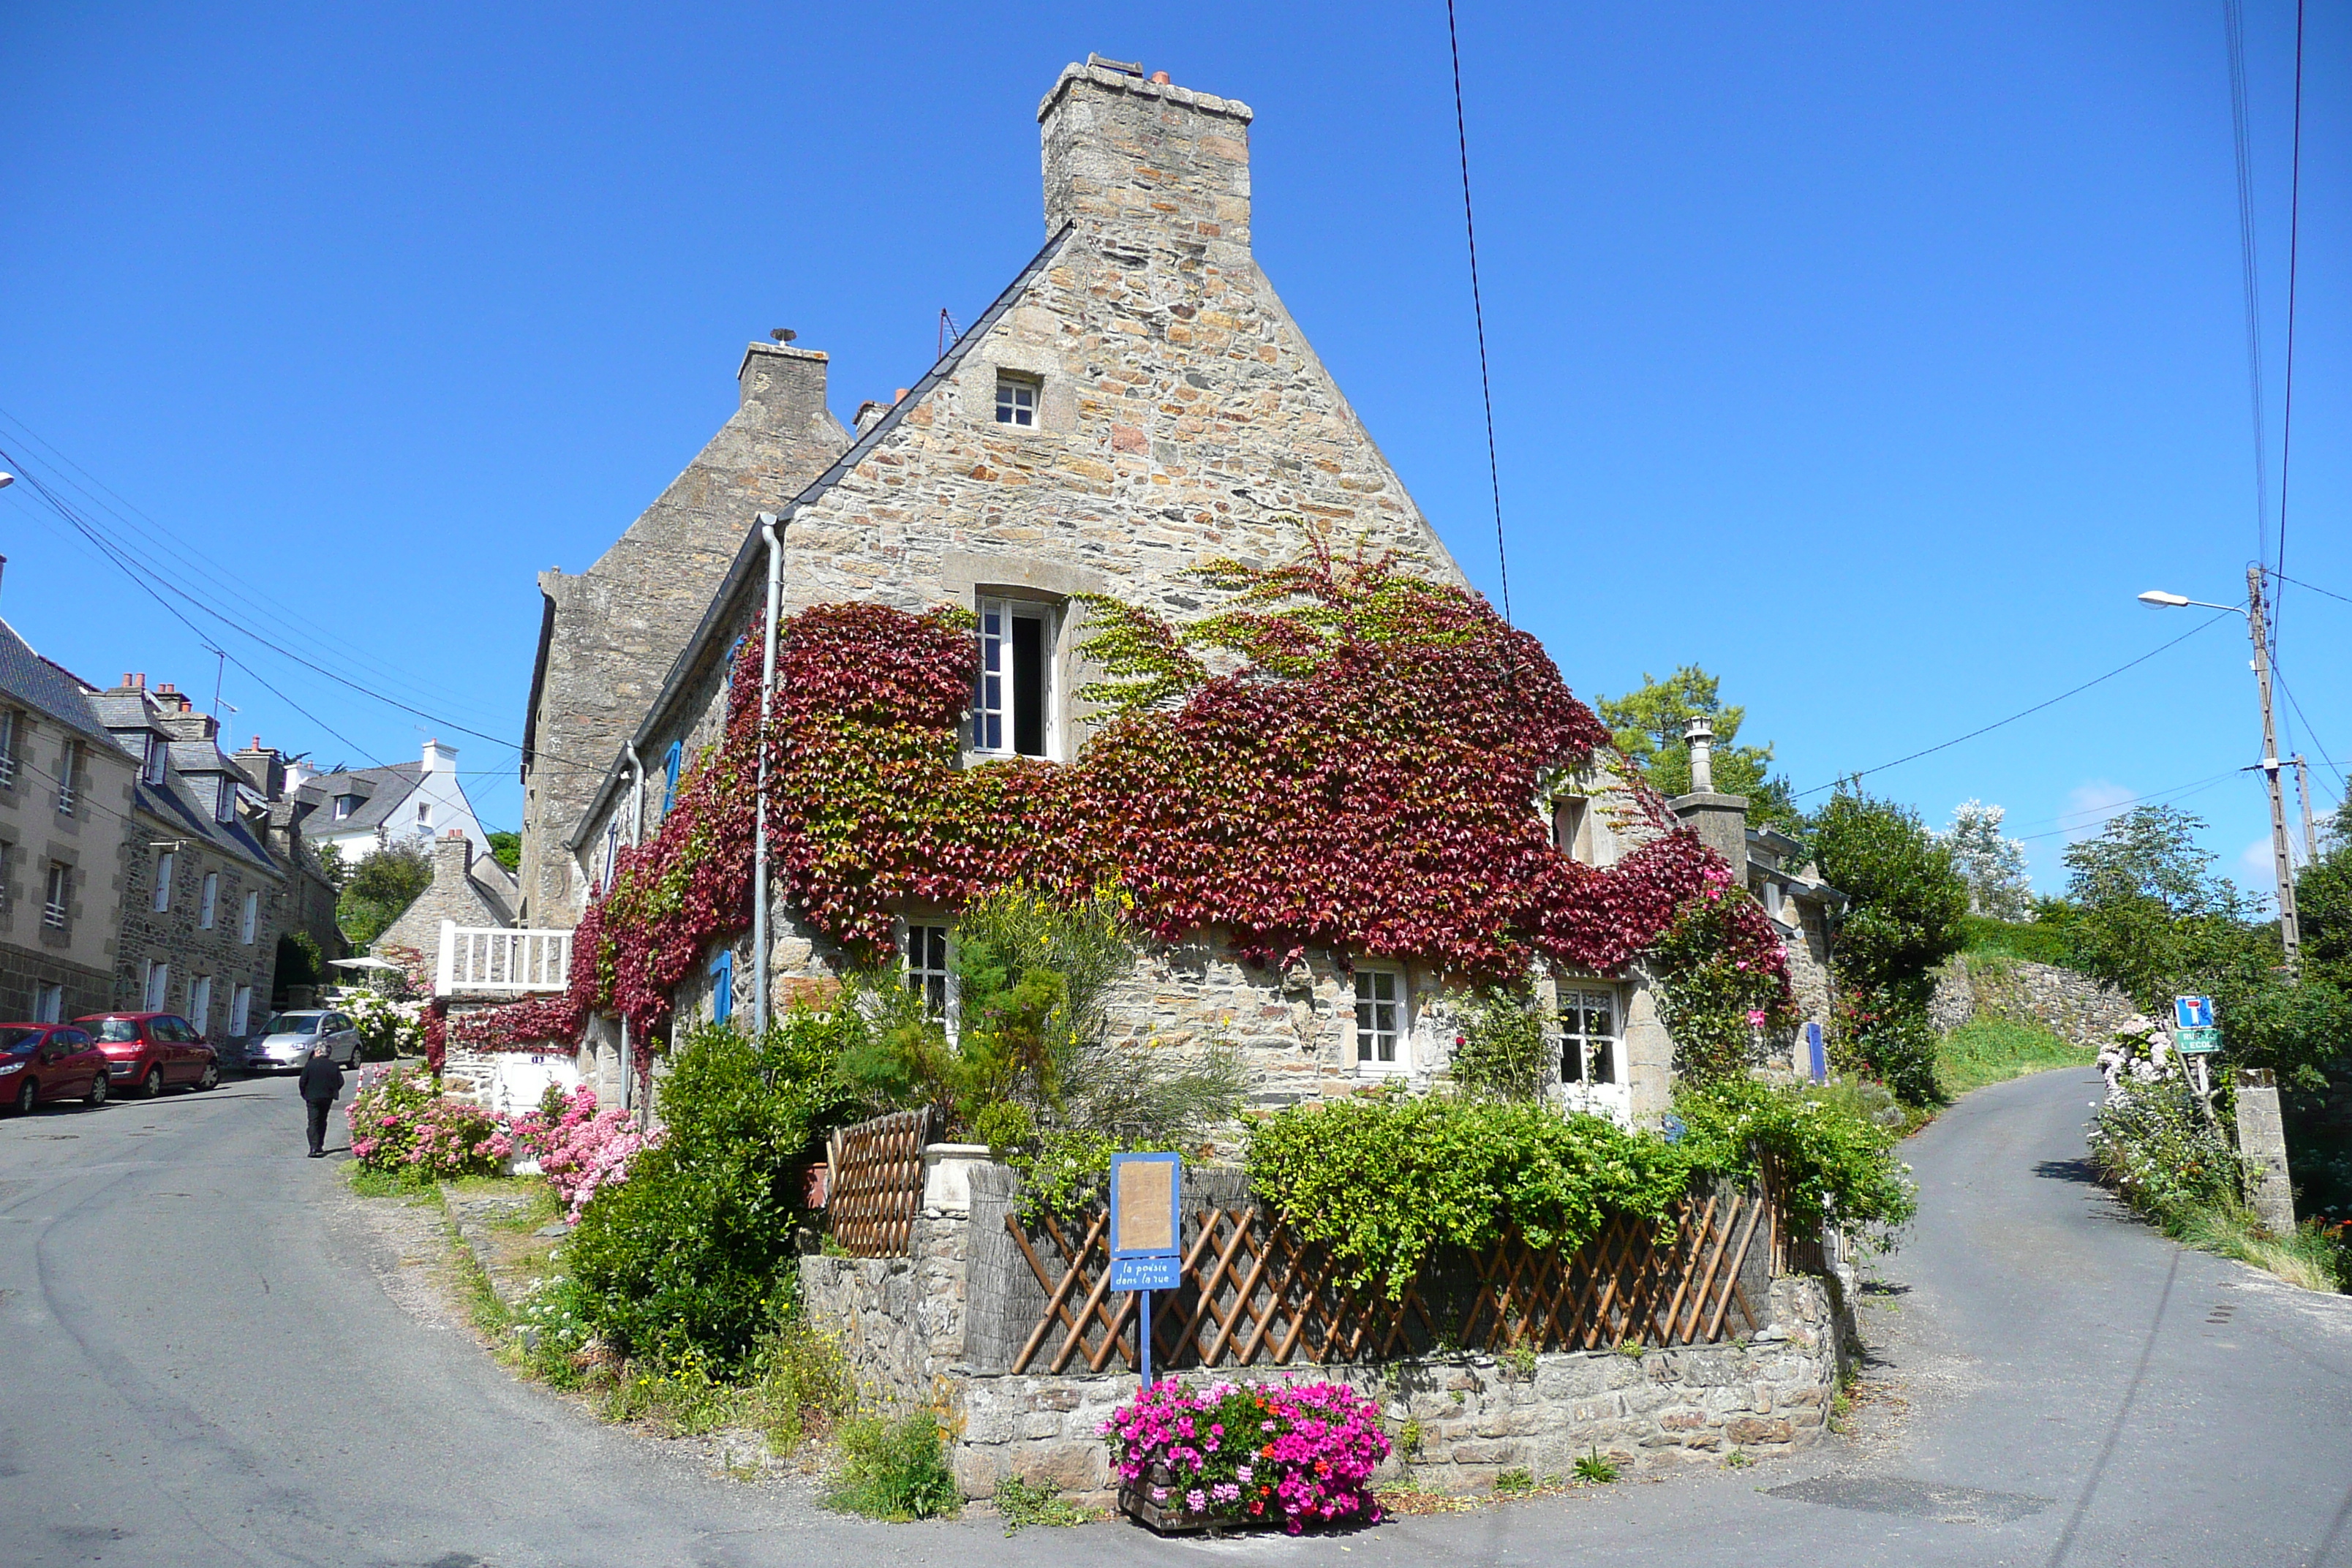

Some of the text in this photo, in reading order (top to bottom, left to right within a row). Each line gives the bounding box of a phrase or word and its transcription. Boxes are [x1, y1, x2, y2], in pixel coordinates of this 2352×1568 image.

[1123, 1262, 1132, 1273] la
[1116, 1273, 1169, 1285] dans la rue
